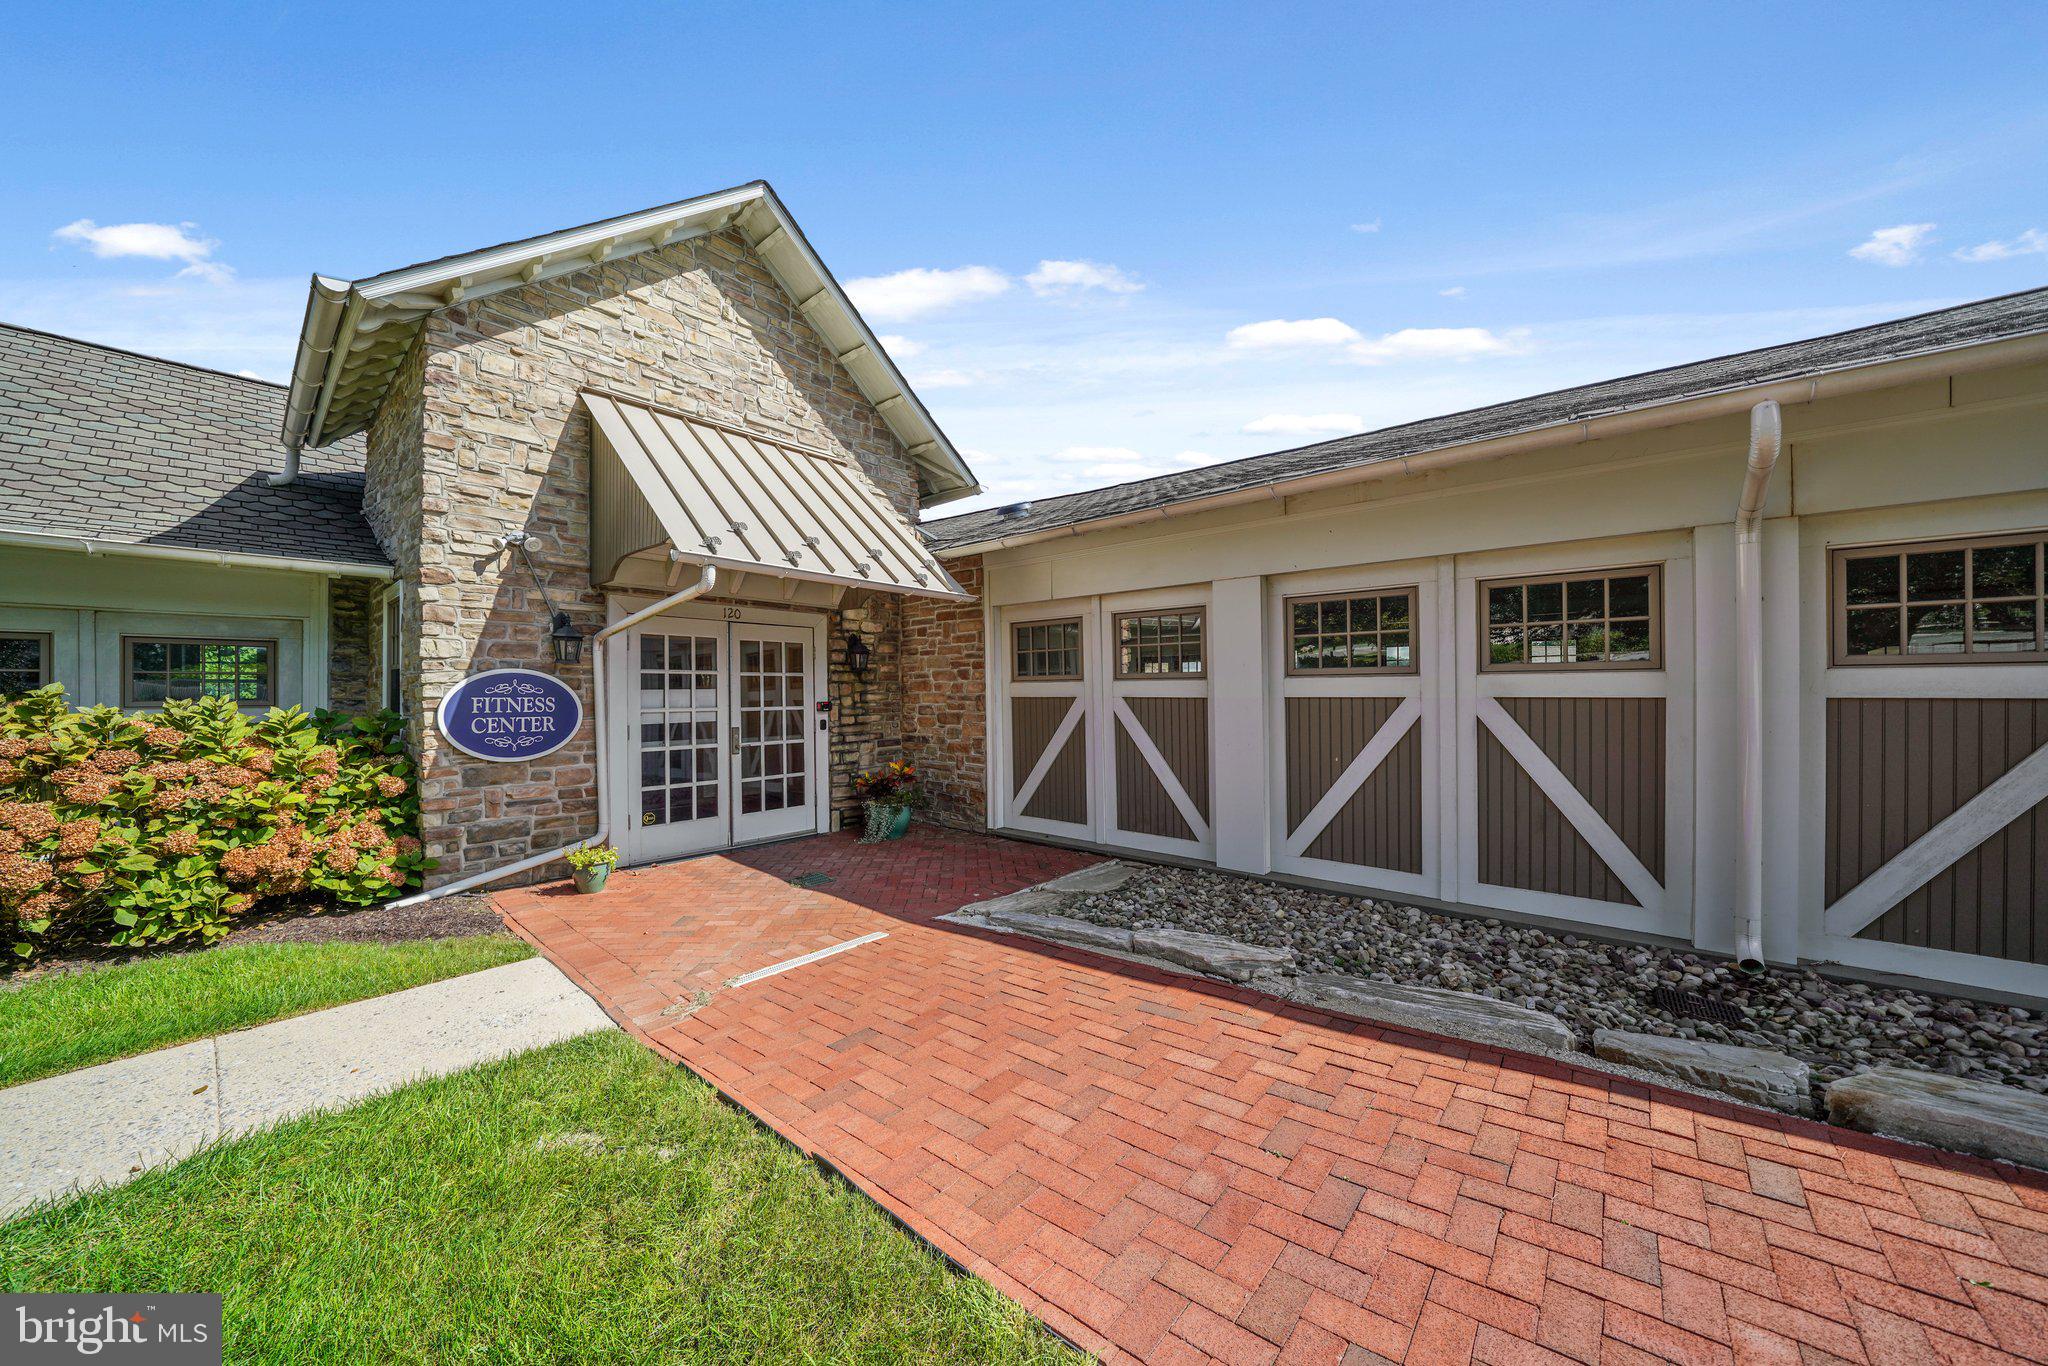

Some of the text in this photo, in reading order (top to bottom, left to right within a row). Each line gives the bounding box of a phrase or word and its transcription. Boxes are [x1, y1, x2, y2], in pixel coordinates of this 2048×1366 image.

[723, 607, 742, 620] 120
[471, 696, 556, 714] FITNESS
[471, 716, 556, 734] CENTER
